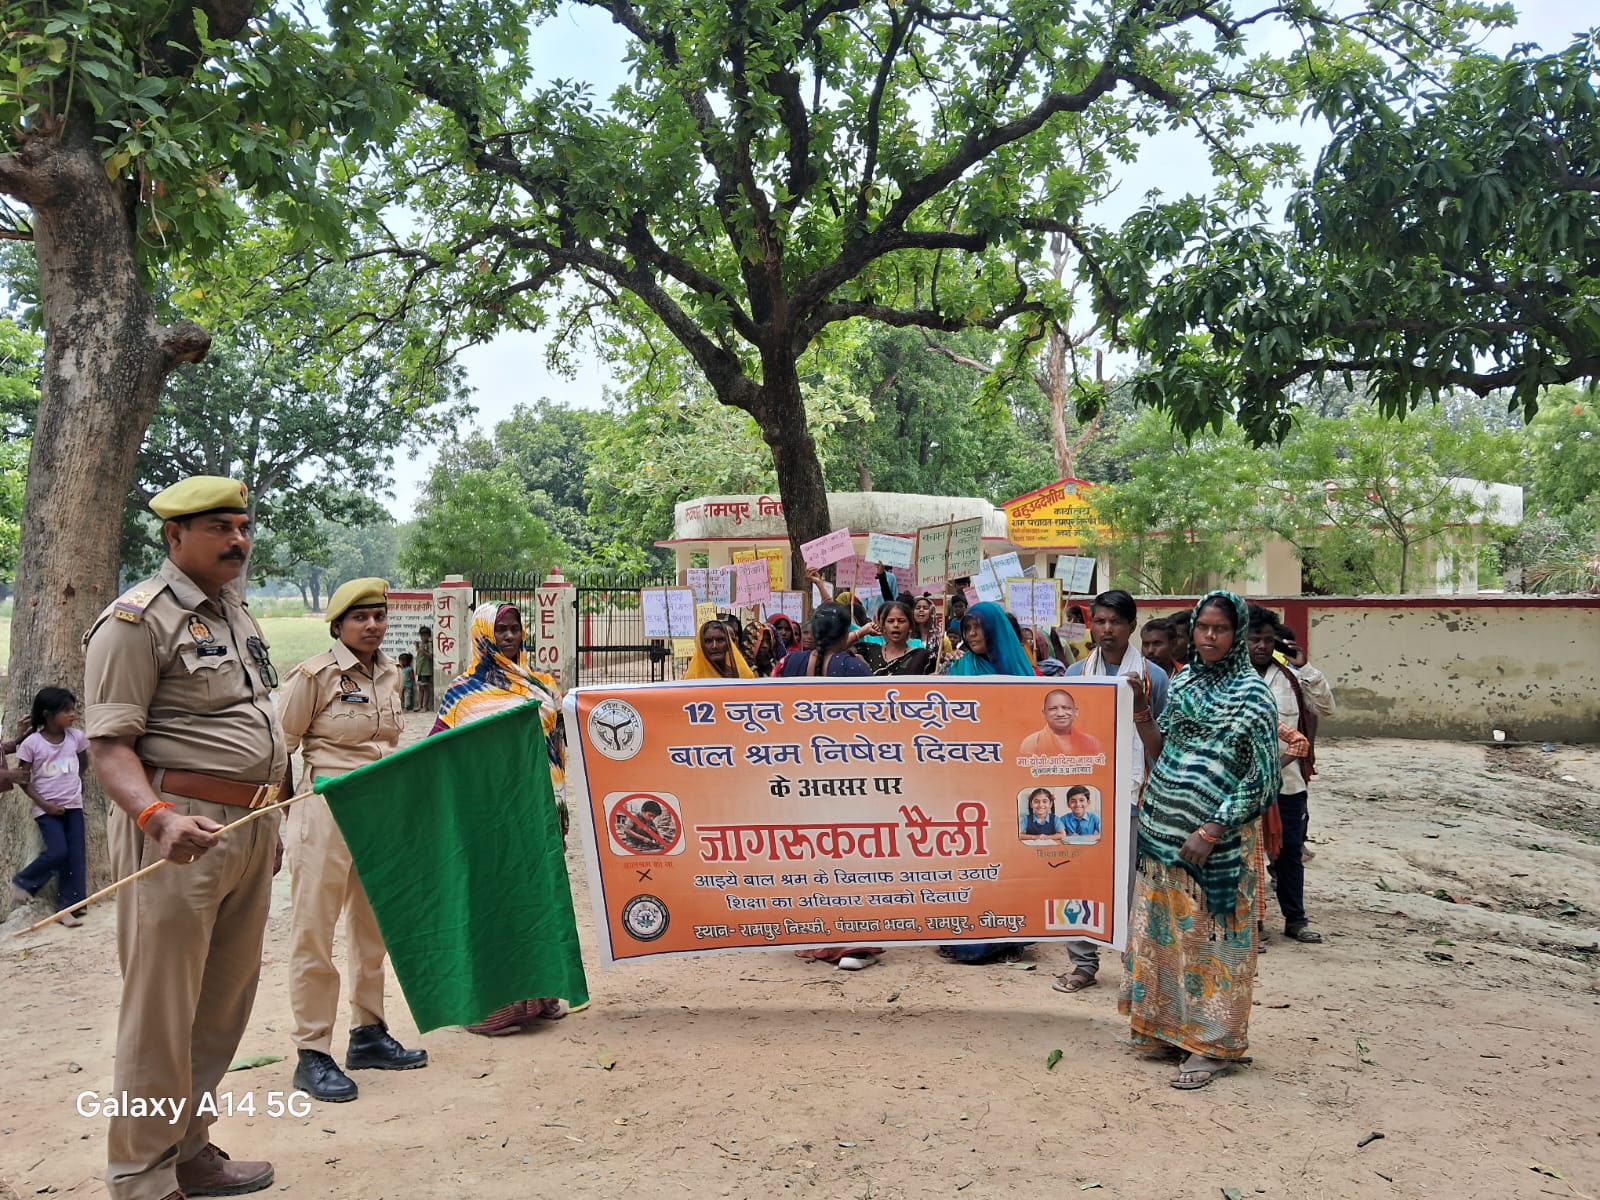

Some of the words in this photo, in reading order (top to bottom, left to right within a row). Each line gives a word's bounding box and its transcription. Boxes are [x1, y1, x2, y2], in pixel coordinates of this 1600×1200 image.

[704, 502, 751, 524] रामपुर
[684, 703, 716, 724] 12
[724, 702, 782, 732] जून
[669, 744, 735, 767] बाल
[745, 743, 801, 765] श्रम
[811, 734, 904, 764] निषेध
[913, 734, 1002, 763] दिवस
[769, 775, 791, 798] के
[798, 776, 867, 798] अवसर
[875, 776, 903, 796] पर
[696, 822, 899, 862] जागरूकता
[899, 802, 990, 858] रैली
[694, 872, 738, 890] आइये
[743, 871, 774, 887] बाल
[780, 871, 808, 886] श्रम
[813, 868, 830, 885] के
[835, 866, 894, 885] खिलाफ
[900, 869, 953, 884] आवाज
[726, 894, 767, 910] शिक्षा
[771, 895, 793, 909] का
[798, 891, 863, 909] अधिकार
[867, 888, 916, 906] सबको
[740, 920, 782, 940] रामपुर
[835, 916, 881, 933] पंचायत
[883, 917, 922, 933] भवन,
[926, 915, 975, 935] रामपुर,
[979, 911, 1027, 935] जौनपुर
